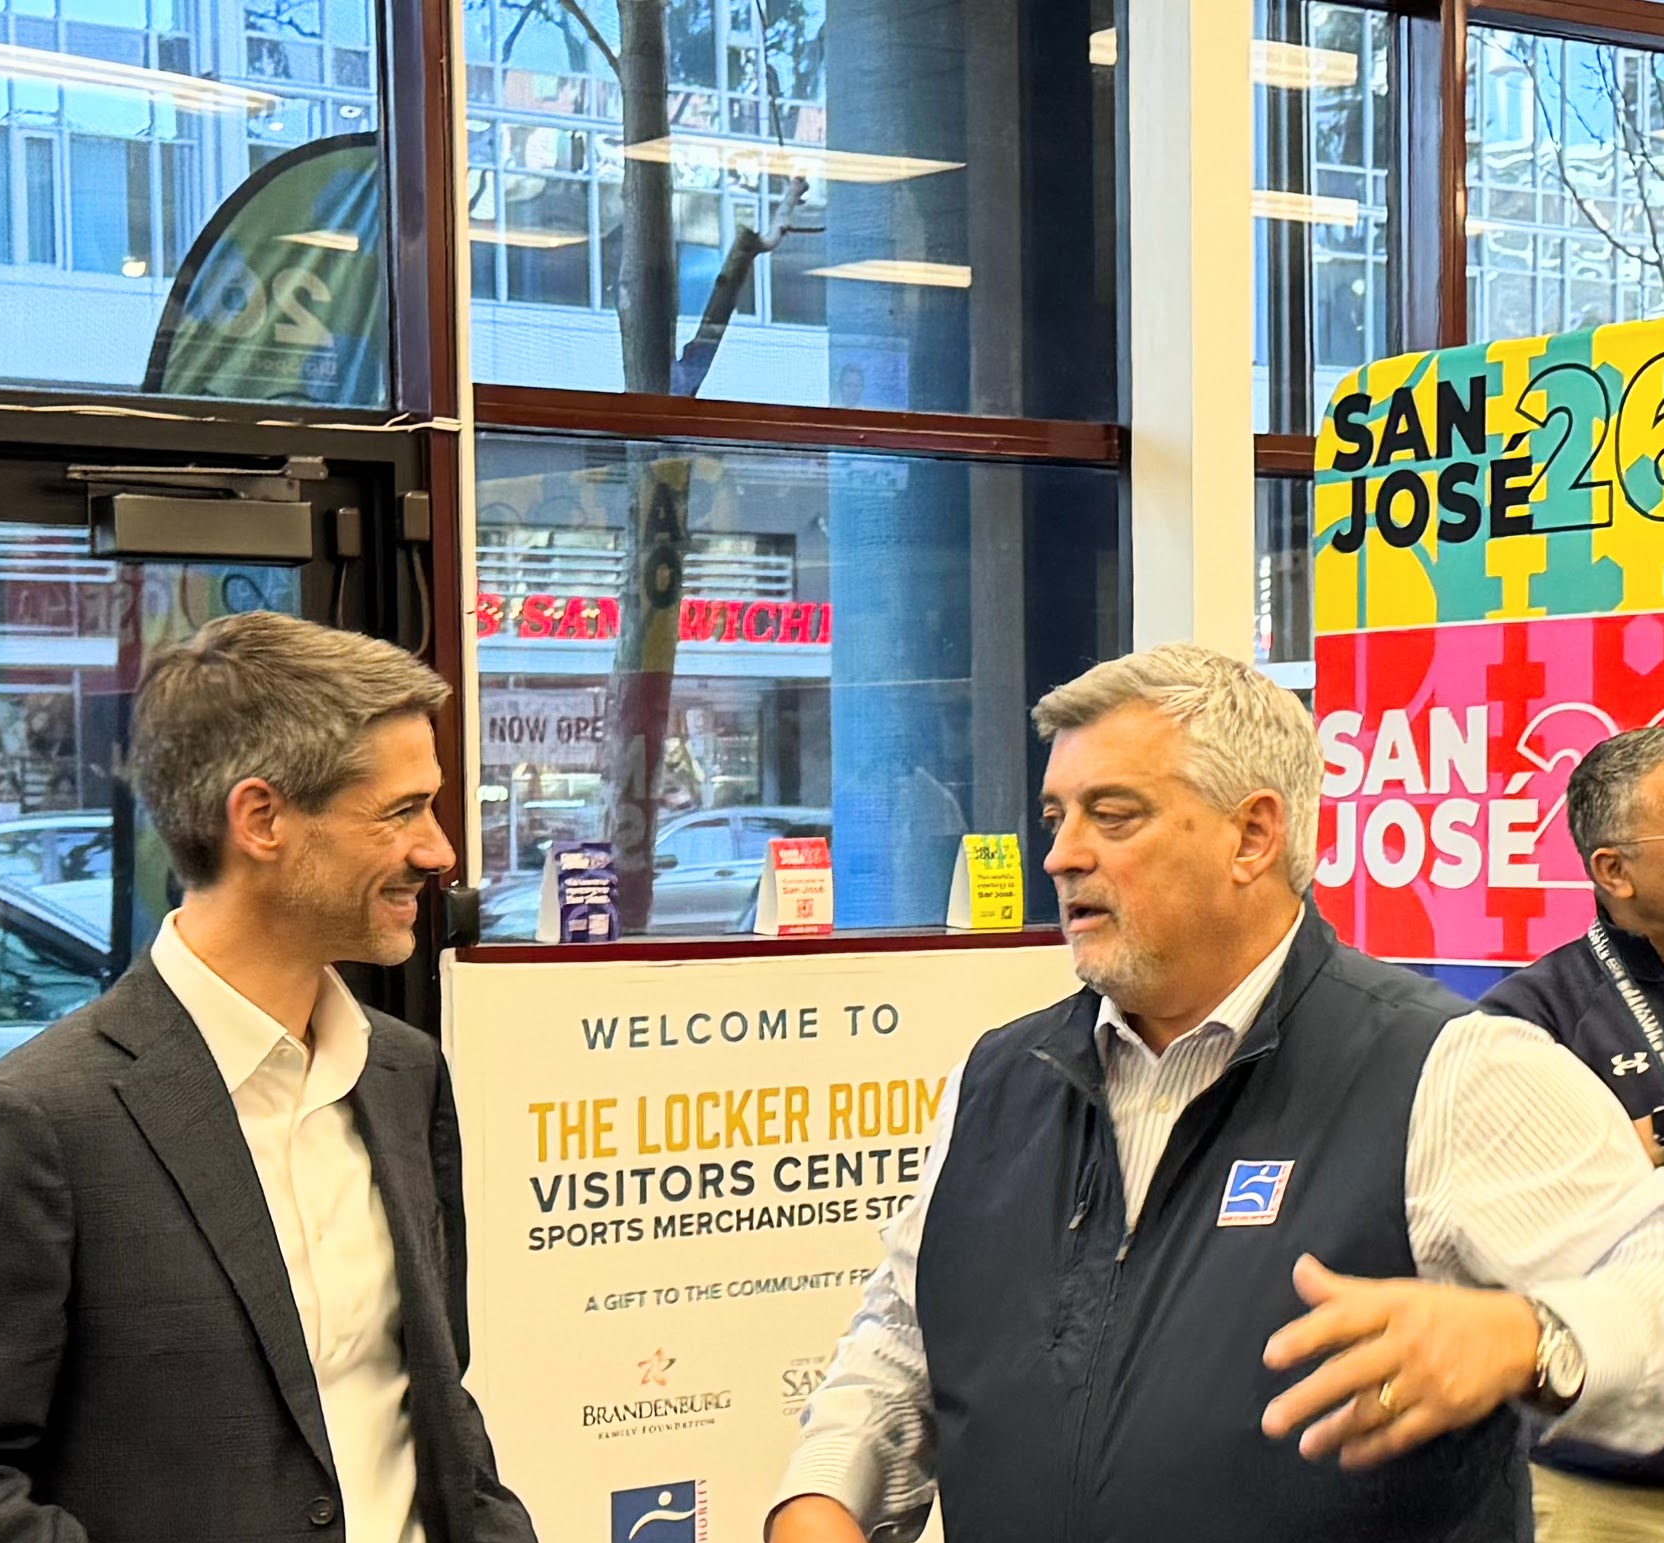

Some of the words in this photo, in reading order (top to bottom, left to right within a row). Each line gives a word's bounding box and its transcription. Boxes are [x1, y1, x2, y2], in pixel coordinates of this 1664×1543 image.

[1333, 374, 1488, 472] SAN
[1333, 432, 1537, 554] JOSÉ
[519, 594, 832, 644] SANWICH
[489, 717, 547, 743] NOW
[556, 716, 605, 742] OPE
[1318, 705, 1488, 797] SAN
[1315, 772, 1539, 888] JOSÉ
[581, 1006, 820, 1051] WELCOME
[845, 1003, 900, 1037] TO
[528, 1097, 618, 1163] THE
[636, 1085, 810, 1156] LOCKER
[828, 1076, 948, 1141] ROOM
[529, 1159, 756, 1214] VISITORS
[773, 1146, 932, 1193] CENTE
[528, 1217, 645, 1251] SPORTS
[653, 1198, 858, 1240] MERCHANDISE
[865, 1194, 916, 1221] STO
[584, 1296, 600, 1313] A
[603, 1290, 648, 1312] GIFT
[653, 1287, 680, 1306] TO
[685, 1282, 724, 1302] THE
[727, 1270, 846, 1299] COMMUNITY
[582, 1389, 733, 1428] BRANDENBURG
